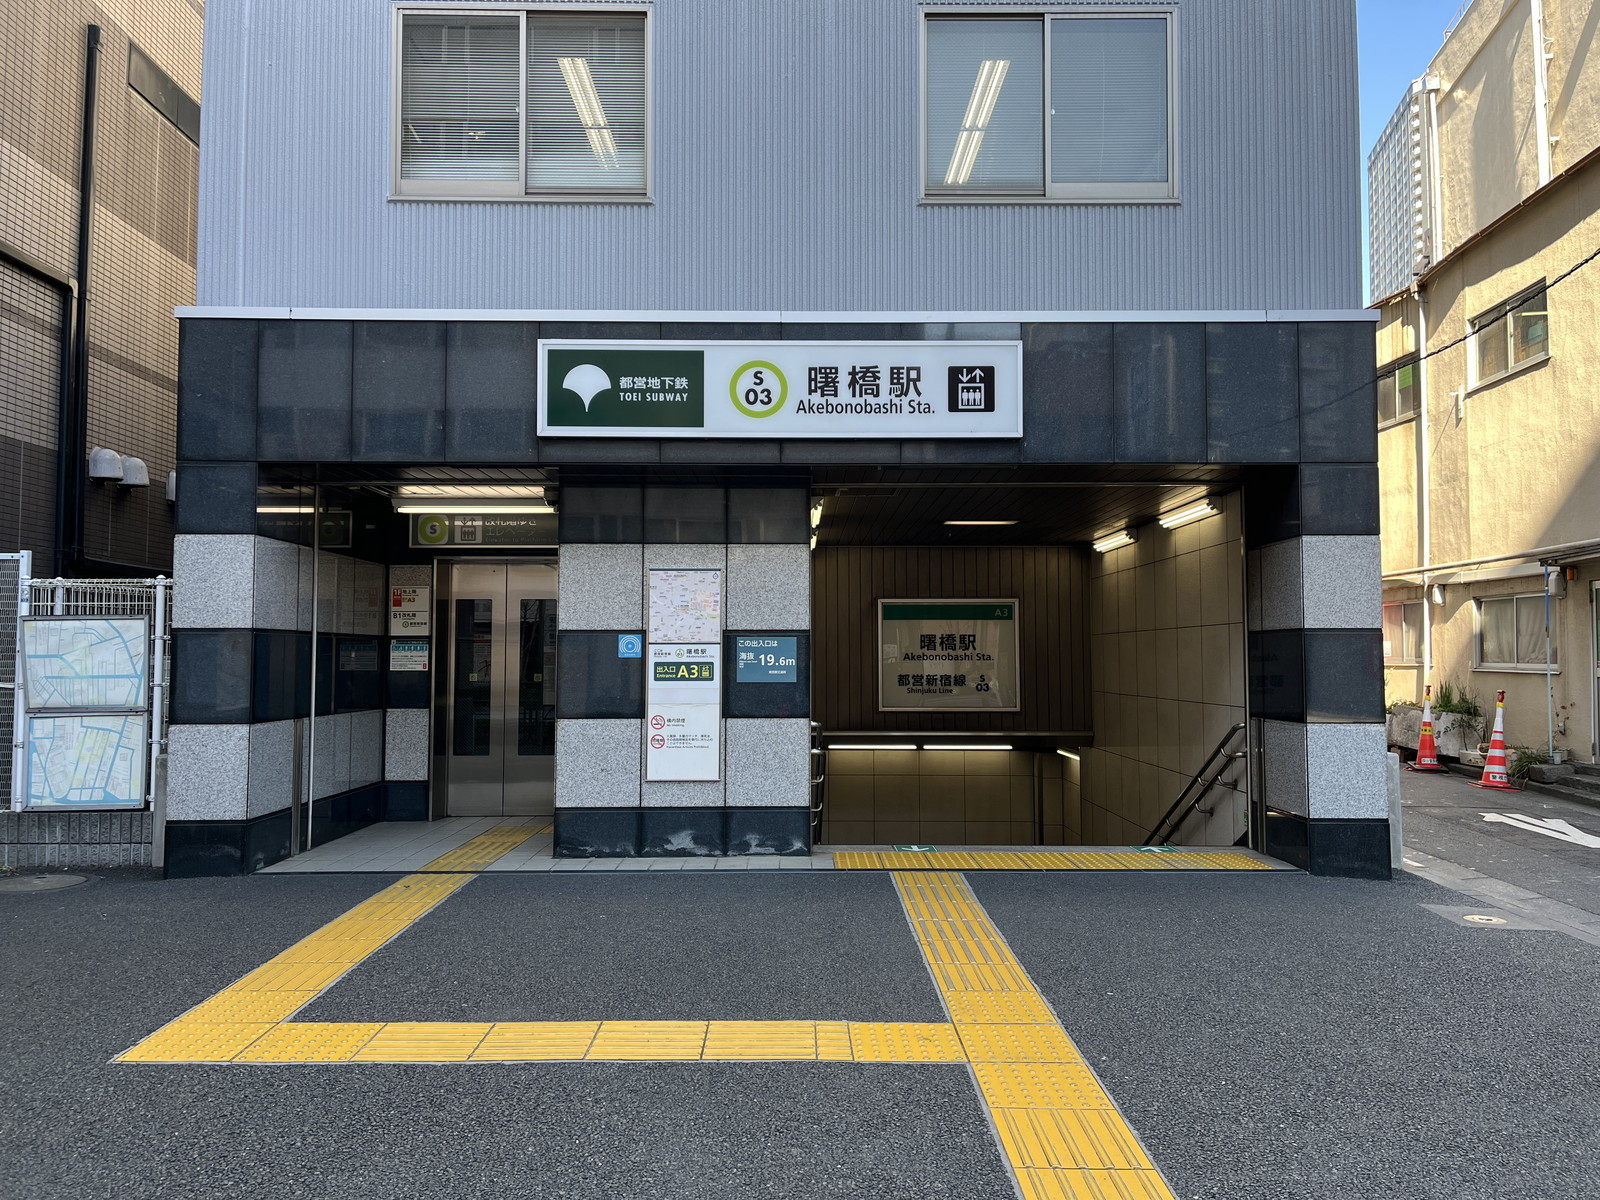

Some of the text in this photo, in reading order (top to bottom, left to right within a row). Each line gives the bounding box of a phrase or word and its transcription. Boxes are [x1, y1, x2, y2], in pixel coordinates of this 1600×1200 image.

[619, 376, 689, 389] 都営地下鉄
[753, 370, 763, 386] S
[807, 365, 922, 398] 曙橋駅
[619, 392, 688, 401] TOEI SUBWAY
[745, 388, 772, 406] 03
[796, 399, 936, 414] Akebonobashi Sta.
[429, 524, 438, 534] S
[994, 608, 1009, 617] A3
[920, 634, 976, 651] 曙橋駅
[739, 652, 796, 666] 海抜 19.6m
[903, 652, 994, 661] Akebonobashi Sta.
[656, 665, 676, 673] 出入口
[677, 664, 699, 678] A3
[897, 674, 967, 687] 都営新宿線
[980, 674, 986, 682] S
[906, 687, 937, 695] Shinjuku
[975, 683, 990, 692] 03
